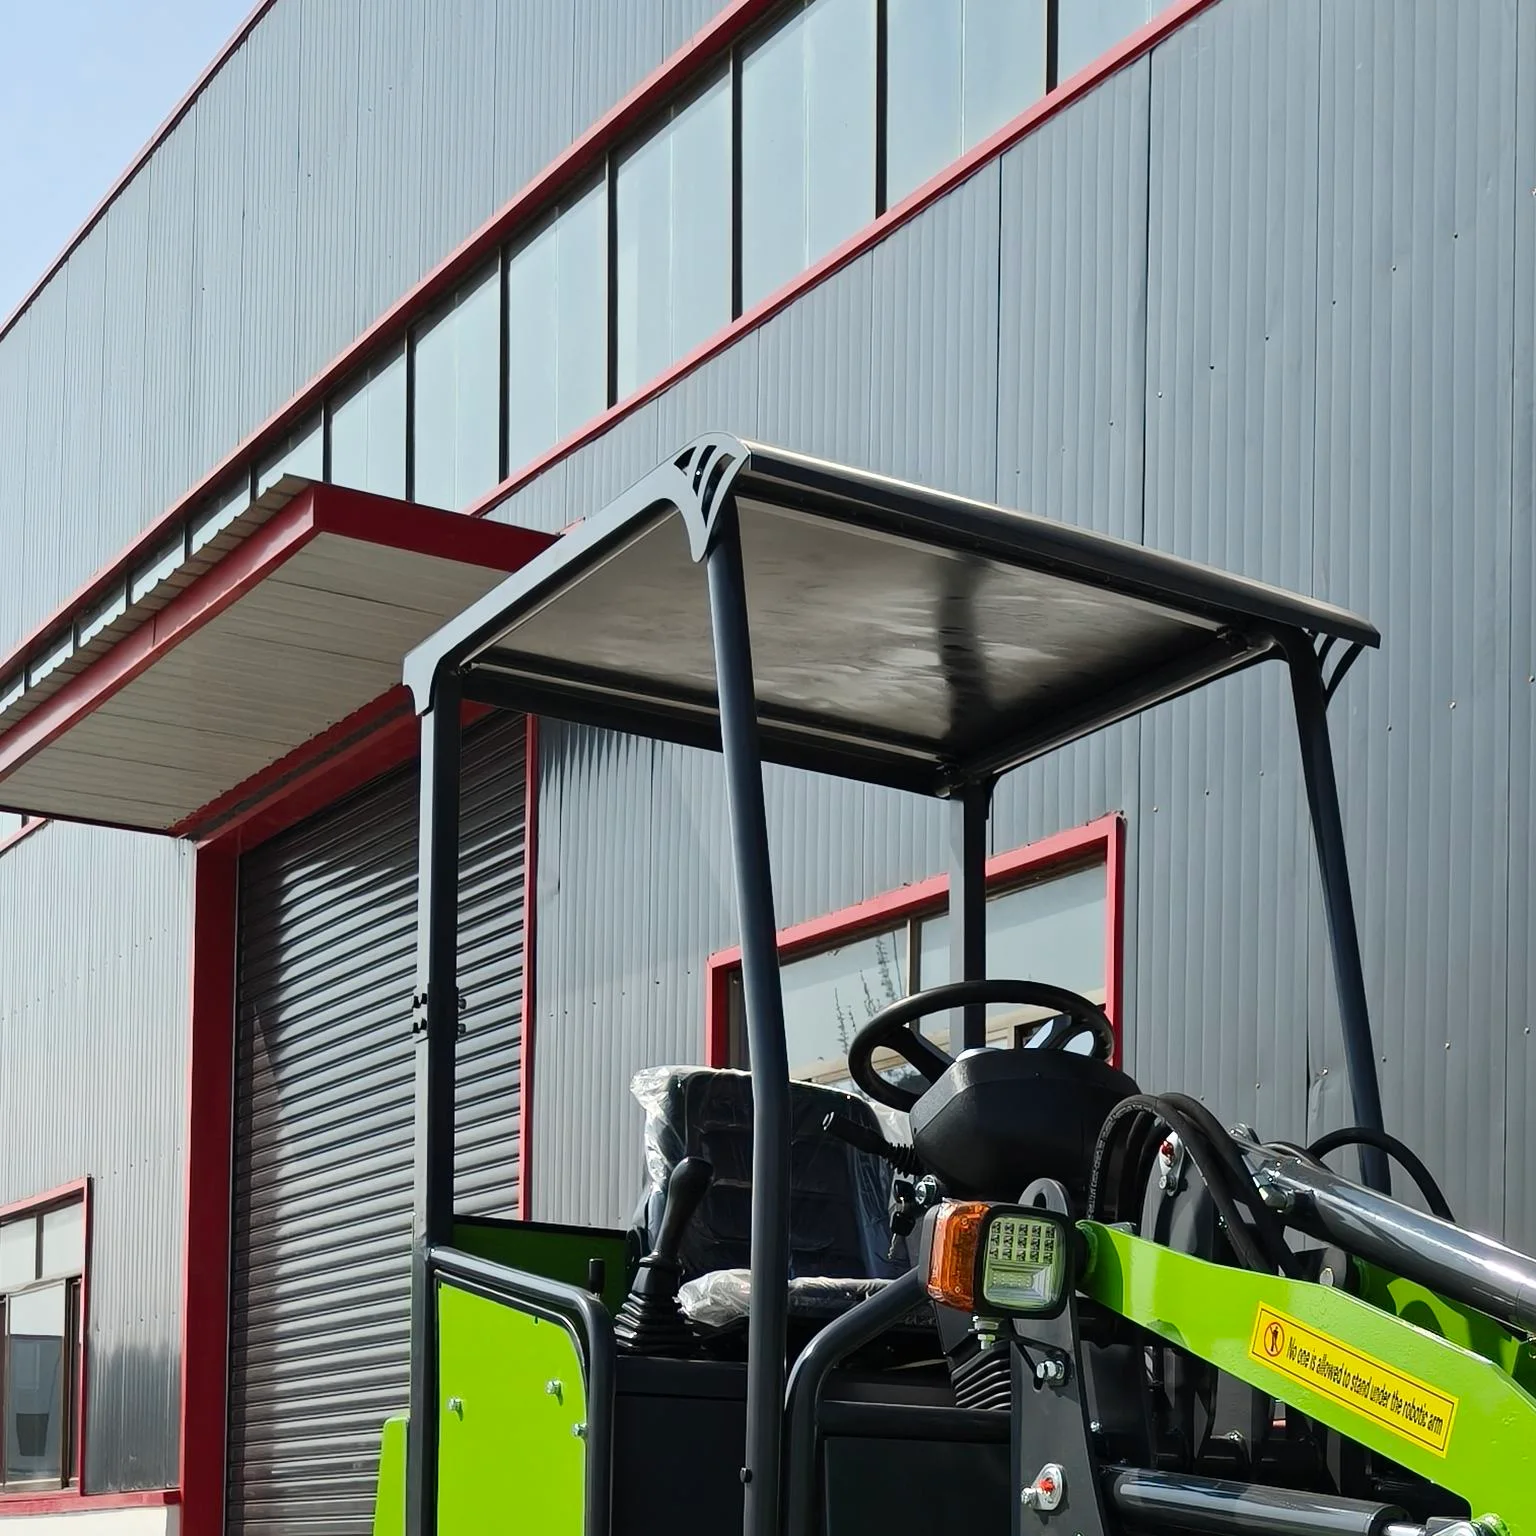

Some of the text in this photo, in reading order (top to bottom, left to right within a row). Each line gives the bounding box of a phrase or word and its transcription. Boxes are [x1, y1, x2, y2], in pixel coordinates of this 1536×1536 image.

[1286, 1336, 1444, 1436] No one is allowed to stand under the robotic arm
